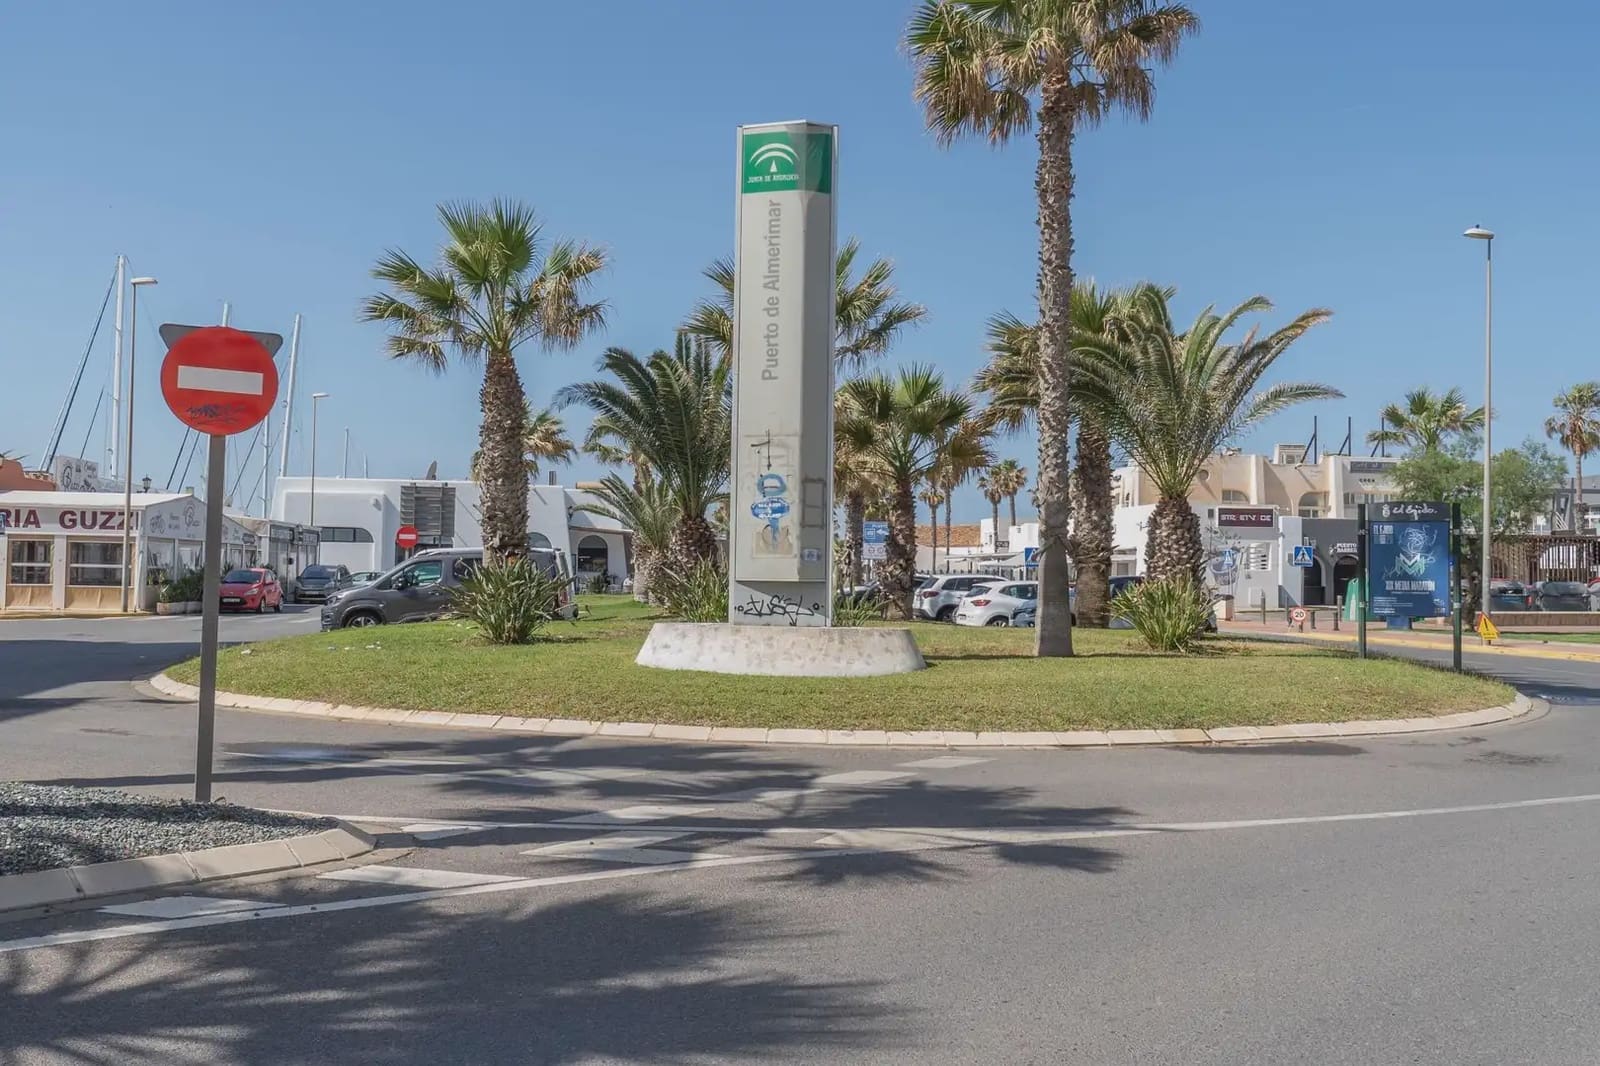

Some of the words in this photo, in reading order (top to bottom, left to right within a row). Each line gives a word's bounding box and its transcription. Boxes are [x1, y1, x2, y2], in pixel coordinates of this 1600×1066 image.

[763, 200, 782, 291] Almerimar
[762, 296, 780, 317] de
[761, 323, 779, 381] Puerto
[0, 509, 41, 528] RIA
